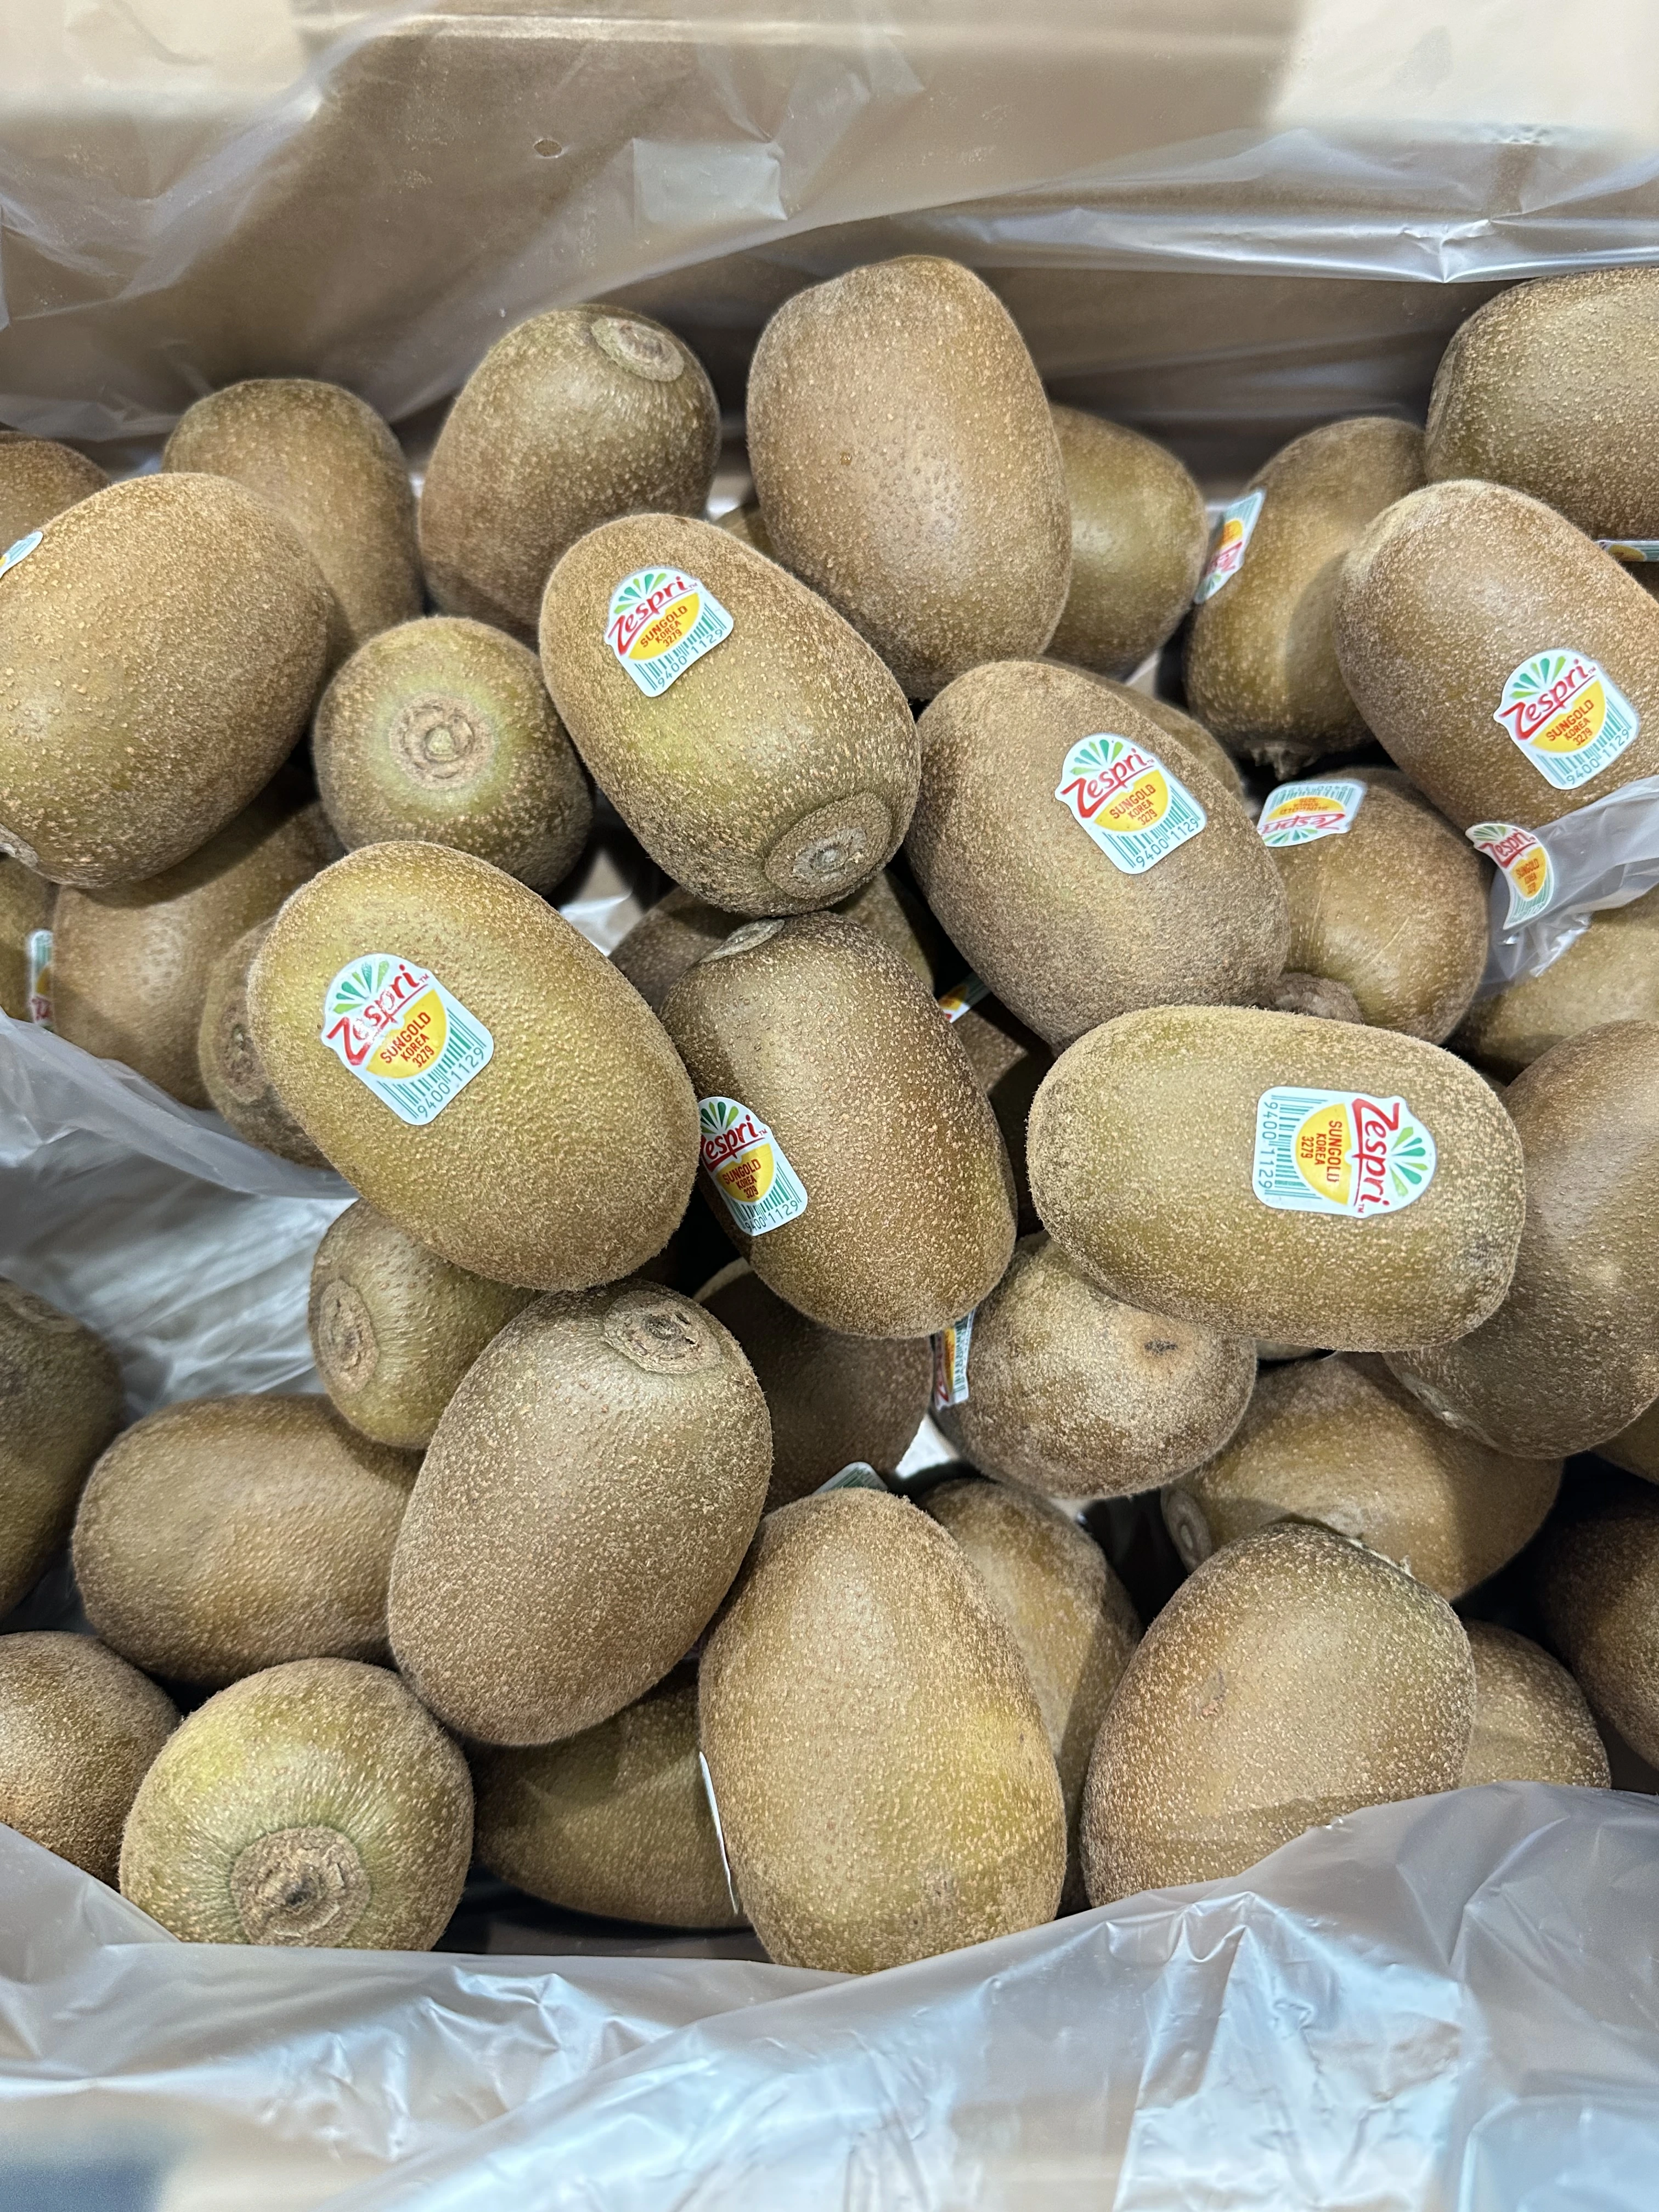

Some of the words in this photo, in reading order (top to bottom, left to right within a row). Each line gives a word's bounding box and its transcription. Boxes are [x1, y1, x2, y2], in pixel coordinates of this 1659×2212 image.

[608, 576, 694, 656] Zespri
[640, 605, 688, 648] SUNGOLD
[655, 620, 681, 644] KOREA
[663, 629, 682, 647] 3279
[658, 656, 687, 687] 9400
[691, 629, 723, 654] 1129
[1498, 659, 1596, 740] Zespri
[1545, 699, 1594, 741] SUNGOLD
[1564, 718, 1590, 741] KOREA
[1573, 727, 1593, 746] 3279
[1566, 758, 1600, 785] 9400
[1602, 729, 1629, 758] 1129
[1060, 748, 1154, 818] Zespri
[1127, 799, 1154, 819] KOREA
[1137, 809, 1158, 825] 3279
[1136, 838, 1169, 868] 9400
[1171, 817, 1200, 840] 1129
[1478, 828, 1536, 869] Zespri
[326, 964, 428, 1065] Zespri
[380, 1012, 431, 1063] SUNGOLD
[400, 1034, 430, 1062] KOREA
[412, 1046, 435, 1068] 3279
[418, 1082, 450, 1118] 9400
[451, 1047, 484, 1081] 1129
[1262, 1102, 1278, 1140] 9400
[1300, 1136, 1314, 1159] 3279
[1314, 1133, 1327, 1165] KOREA
[1327, 1120, 1342, 1182] SUNGOLD
[1351, 1098, 1400, 1206] Zespri
[722, 1158, 761, 1185] SUNGOLD
[736, 1175, 757, 1190] KOREA
[1259, 1150, 1276, 1189] 1129
[743, 1185, 759, 1199] 3279
[744, 1217, 766, 1233] 9400
[768, 1200, 799, 1223] 1129
